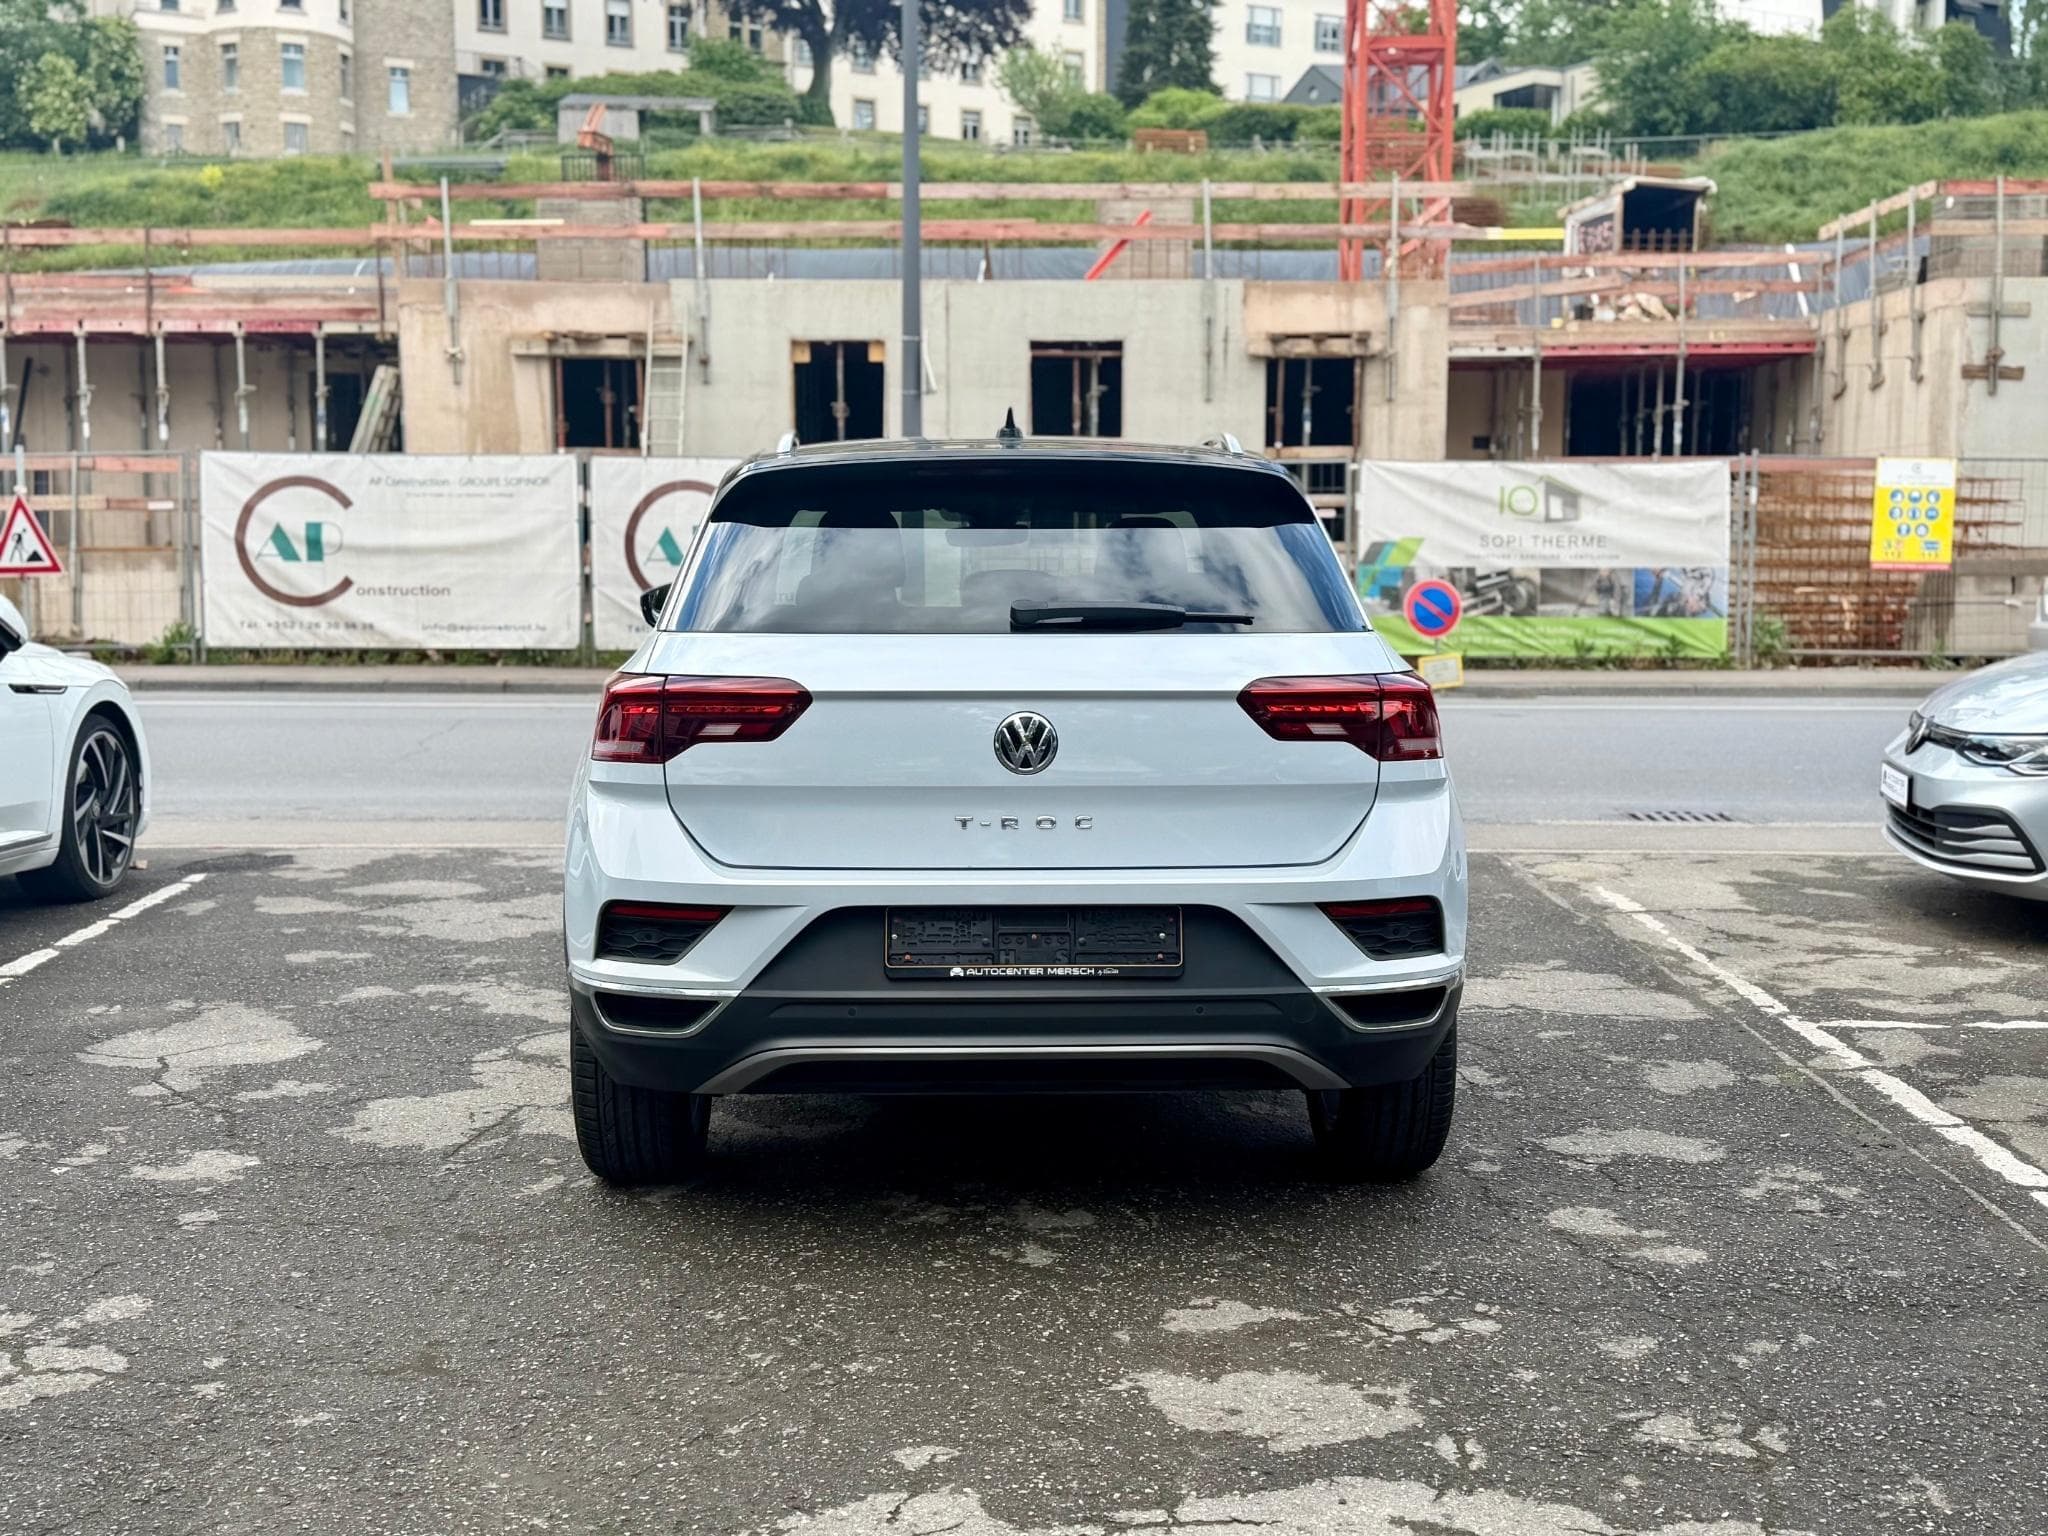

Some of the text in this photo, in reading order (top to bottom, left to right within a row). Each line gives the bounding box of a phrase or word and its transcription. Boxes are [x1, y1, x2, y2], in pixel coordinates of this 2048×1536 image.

[1479, 534, 1608, 549] SOPI THERME
[966, 966, 1045, 977] AUTOCENTER
[1047, 966, 1095, 977] MERSCH
